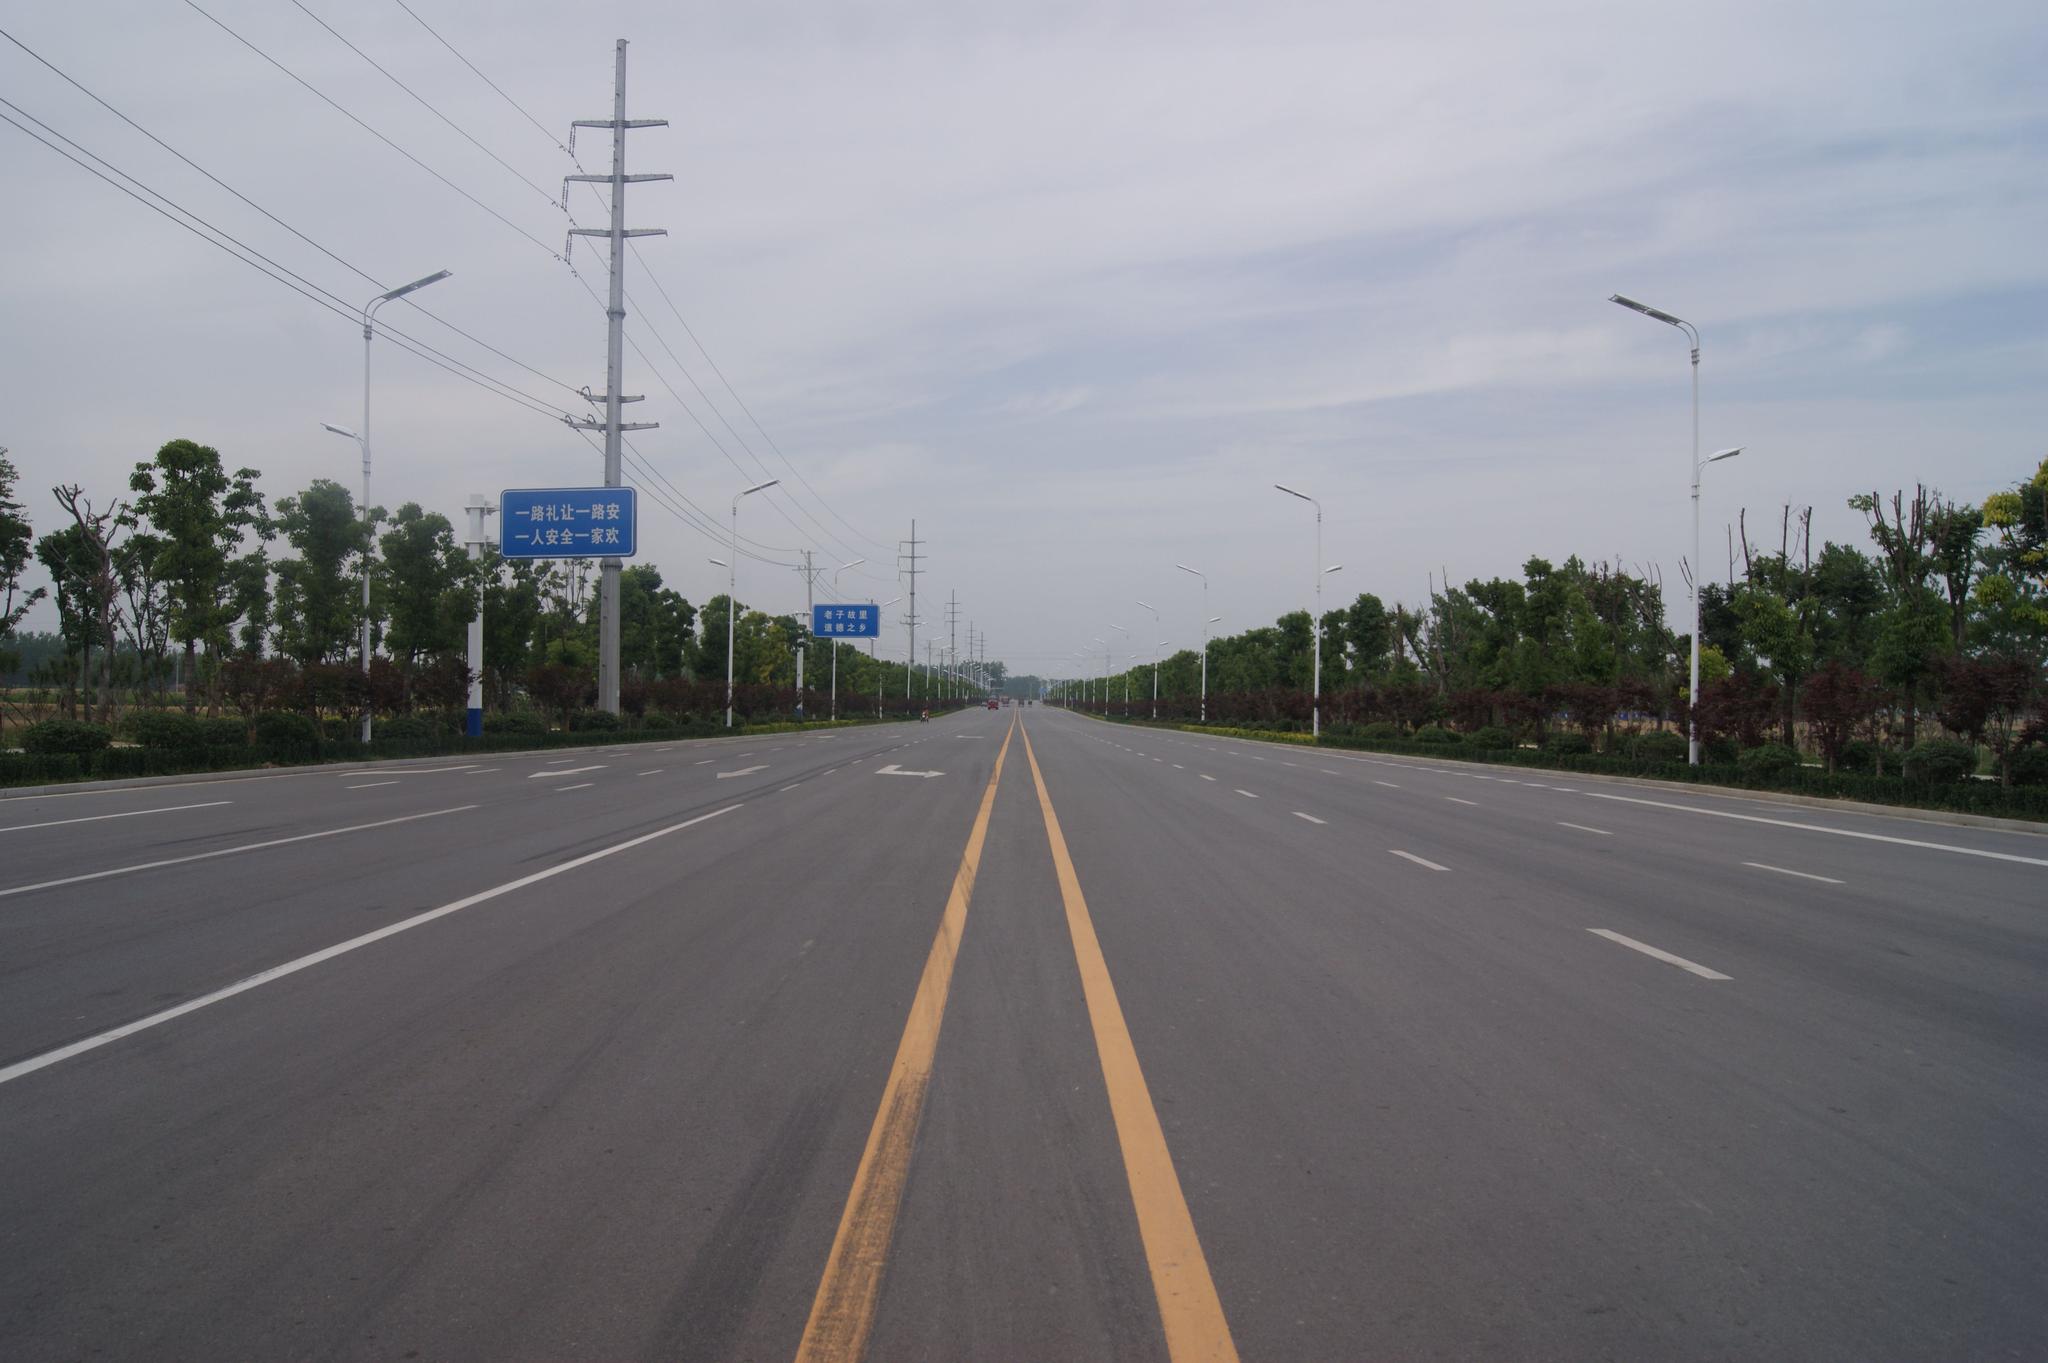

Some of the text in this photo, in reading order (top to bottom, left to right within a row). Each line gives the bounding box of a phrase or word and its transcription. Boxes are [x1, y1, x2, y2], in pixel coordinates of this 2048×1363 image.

[515, 503, 620, 521] 一路礼让一路安
[514, 528, 619, 545] 一人安全一家欢
